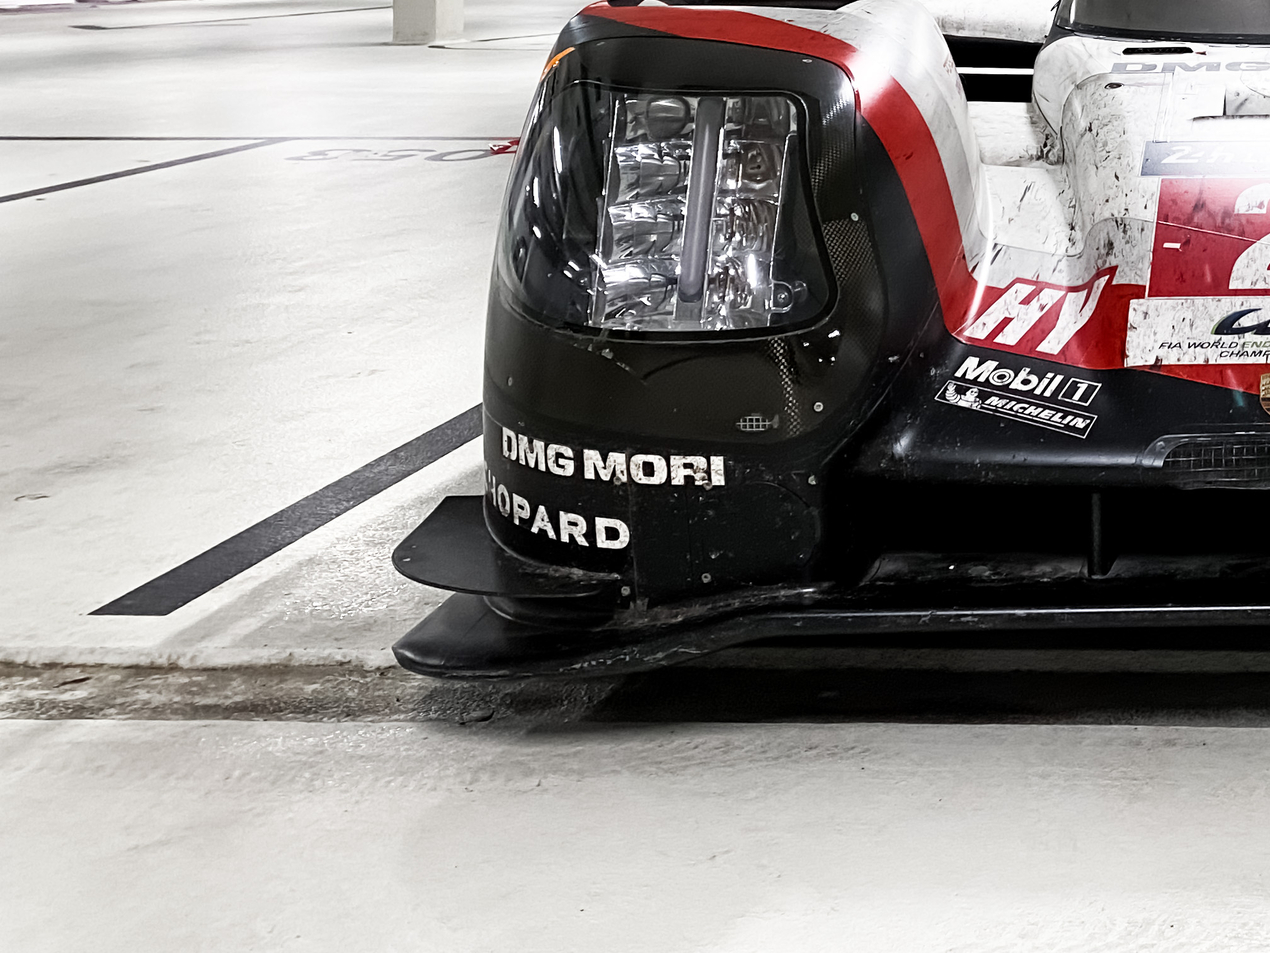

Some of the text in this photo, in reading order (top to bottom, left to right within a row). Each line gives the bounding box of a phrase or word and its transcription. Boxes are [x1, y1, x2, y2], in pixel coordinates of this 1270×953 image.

[1110, 61, 1270, 73] DMG
[963, 274, 1110, 356] HY
[1158, 341, 1183, 349] FIA
[1187, 340, 1239, 349] WORLD
[954, 356, 1089, 402] Mobil 1
[984, 395, 1091, 430] MICHELIN
[502, 426, 726, 486] DMG MORI
[487, 469, 631, 550] HOPARD
